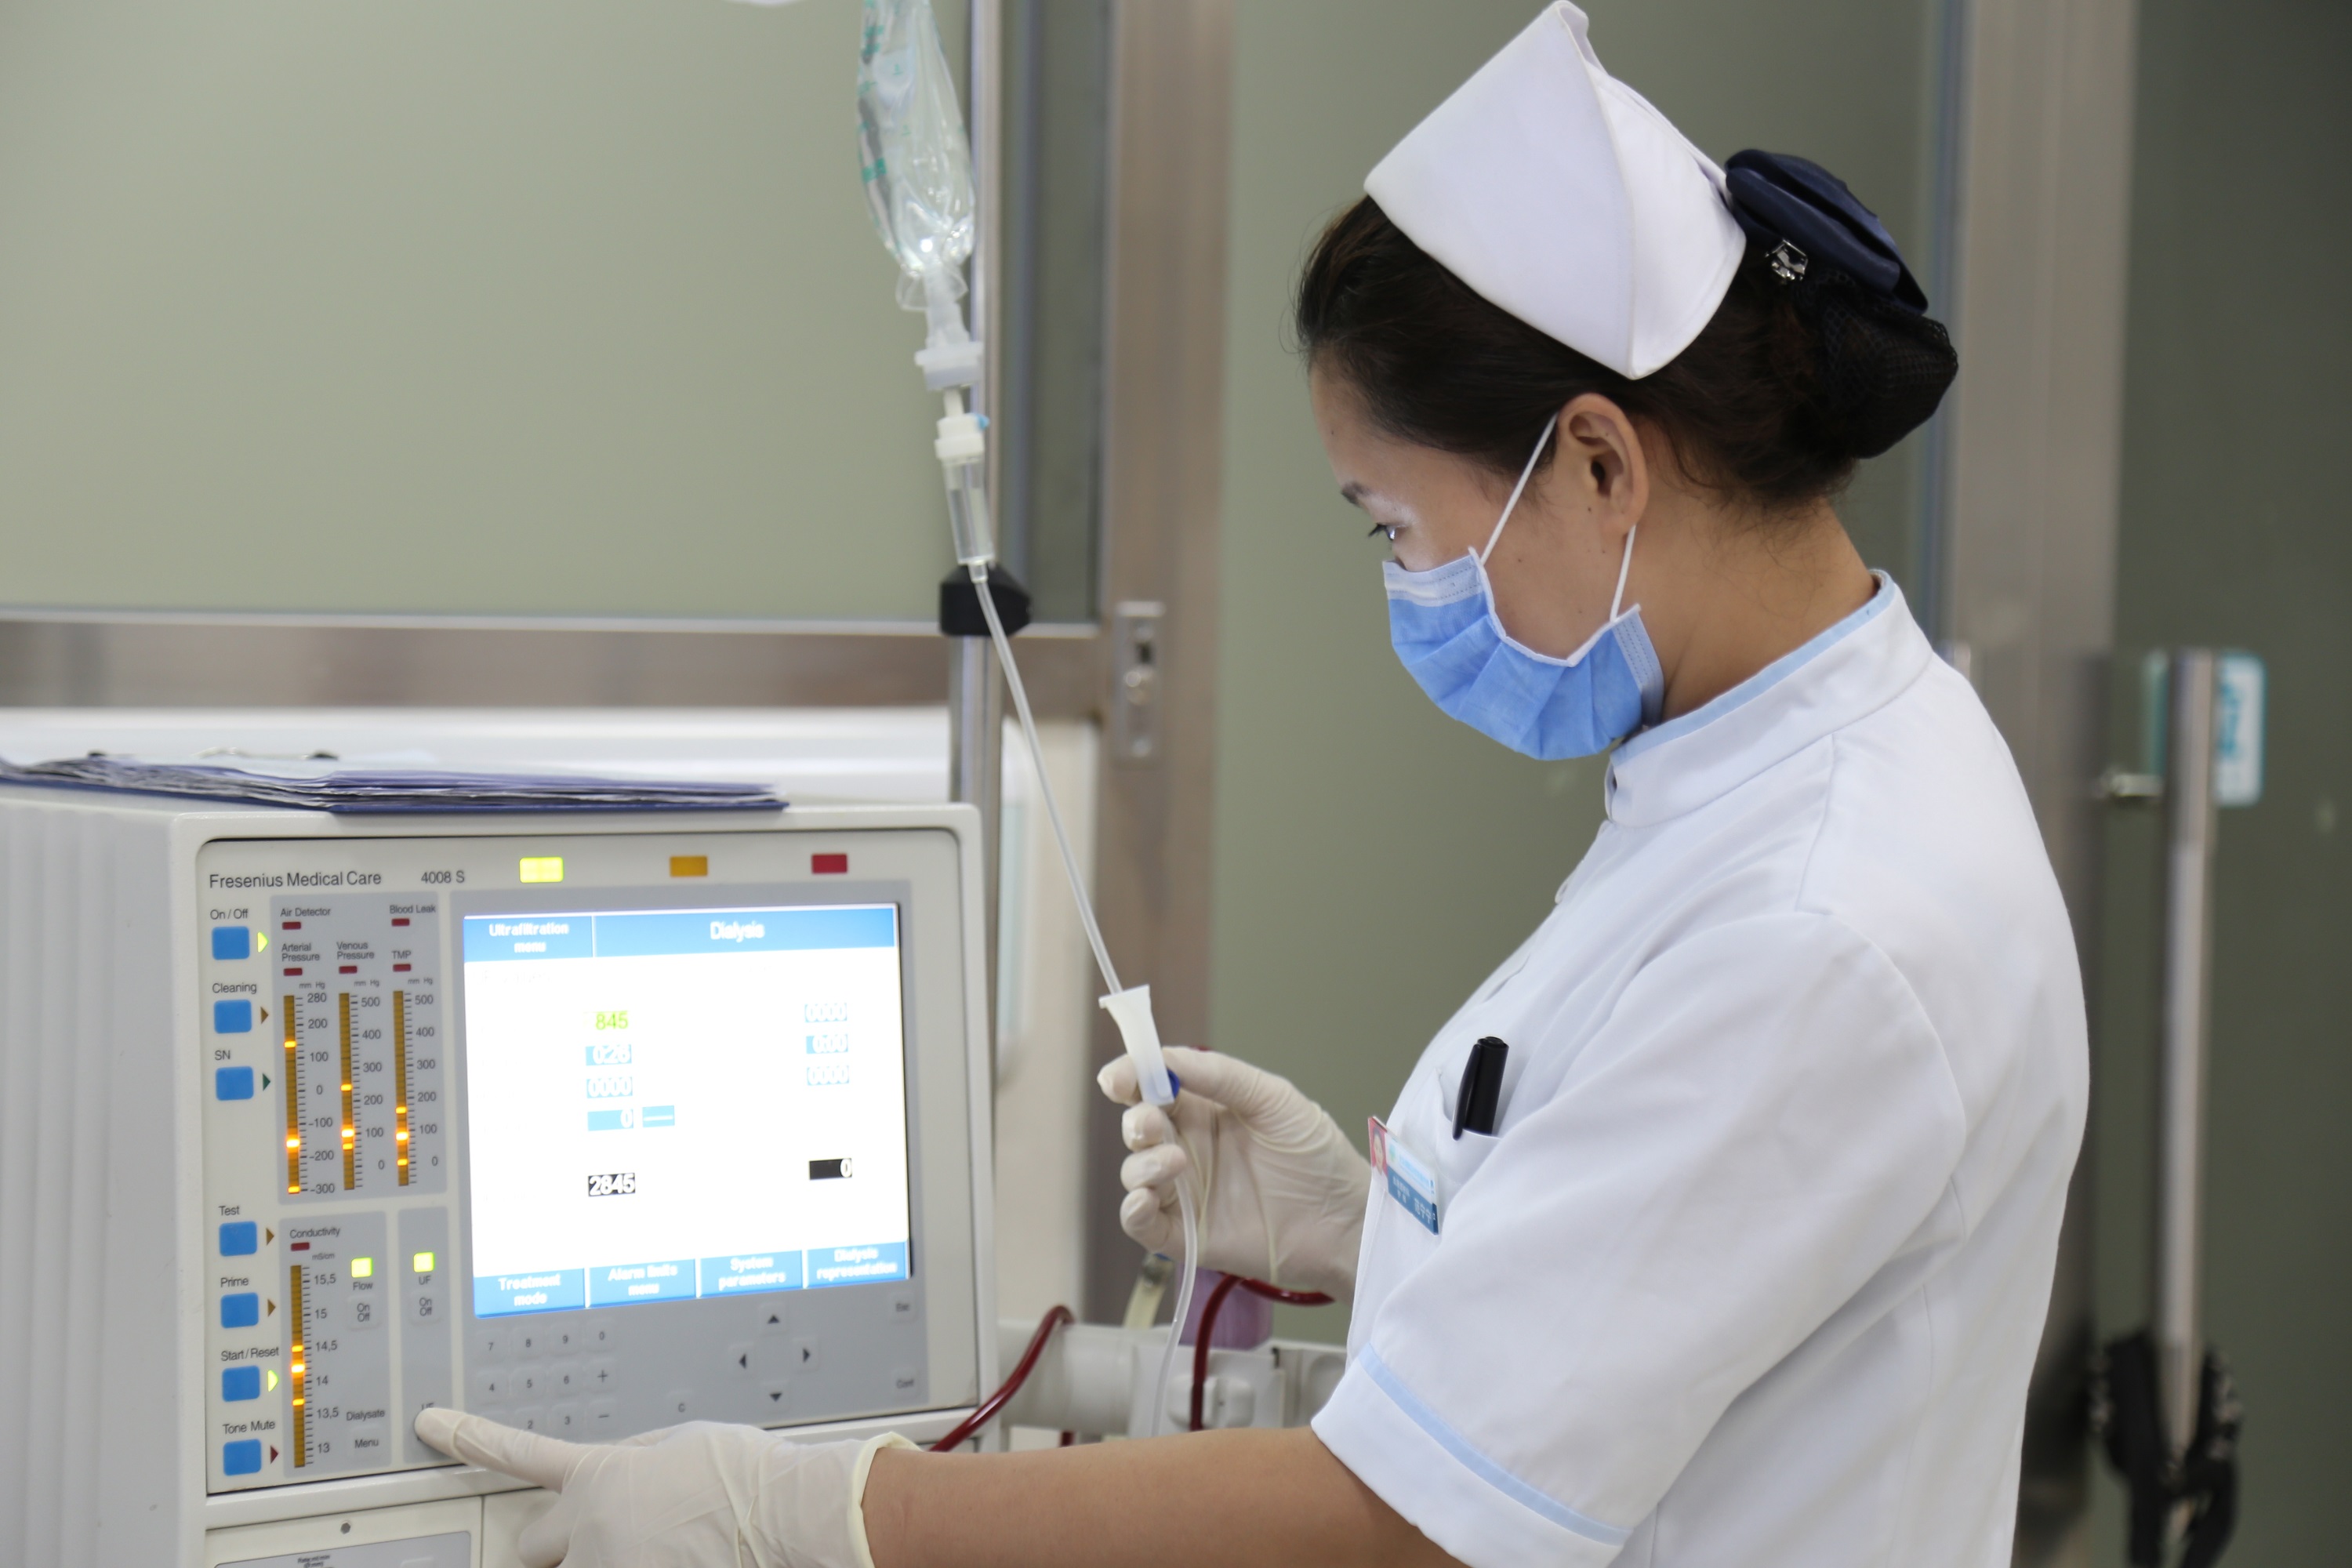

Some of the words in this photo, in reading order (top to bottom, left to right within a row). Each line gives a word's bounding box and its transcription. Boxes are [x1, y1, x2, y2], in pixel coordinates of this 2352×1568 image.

[209, 873, 284, 888] Fresenius
[286, 871, 343, 887] Medical
[346, 870, 382, 886] Care
[420, 870, 452, 884] 4008
[456, 869, 465, 884] S
[209, 909, 226, 920] On
[233, 908, 249, 920] Off
[280, 908, 292, 917] Air
[294, 907, 332, 917] Detector
[389, 904, 414, 914] Blood
[416, 904, 436, 913] Leak
[281, 942, 312, 953] Arterial
[336, 941, 368, 951] Venous
[281, 953, 321, 962] Pressure
[336, 950, 375, 960] Pressure
[391, 949, 412, 960] TMP
[212, 982, 258, 995] Cleaning
[307, 992, 327, 1004] 280
[361, 996, 381, 1007] 500
[415, 994, 434, 1005] 500
[308, 1018, 328, 1029] 200
[596, 1011, 629, 1030] 845
[361, 1029, 382, 1040] 400
[416, 1026, 435, 1037] 400
[214, 1049, 231, 1061] SN
[310, 1051, 329, 1062] 100
[363, 1062, 383, 1073] 300
[416, 1058, 436, 1070] 300
[316, 1084, 324, 1095] 0
[364, 1094, 383, 1105] 200
[417, 1091, 437, 1102] 200
[365, 1127, 384, 1138] 100
[419, 1123, 437, 1134] 100
[378, 1160, 385, 1171] 0
[431, 1156, 439, 1167] 0
[840, 1159, 852, 1178] 0
[589, 1174, 635, 1195] 2845
[218, 1205, 240, 1216] Test
[289, 1226, 341, 1240] Conductivity
[220, 1276, 249, 1288] Prime
[314, 1273, 336, 1286] 15,5
[418, 1275, 431, 1286] UF
[352, 1281, 374, 1291] Flow
[356, 1302, 370, 1313] On
[419, 1297, 433, 1308] On
[314, 1308, 328, 1319] 15
[419, 1306, 433, 1317] Off
[357, 1312, 371, 1323] Off
[562, 1335, 568, 1344] 9
[598, 1330, 605, 1341] 0
[315, 1339, 338, 1352] 14,5
[488, 1341, 494, 1351] 7
[525, 1338, 532, 1348] 8
[316, 1375, 328, 1386] 14
[526, 1379, 533, 1388] 5
[563, 1375, 570, 1385] 6
[488, 1383, 495, 1392] 4
[316, 1406, 339, 1420] 13,5
[346, 1409, 386, 1422] Dialysate
[527, 1420, 534, 1430] 2
[564, 1416, 571, 1425] 3
[222, 1423, 248, 1435] Tone
[250, 1420, 276, 1432] Mute
[318, 1442, 330, 1454] 13
[354, 1439, 379, 1449] Menu
